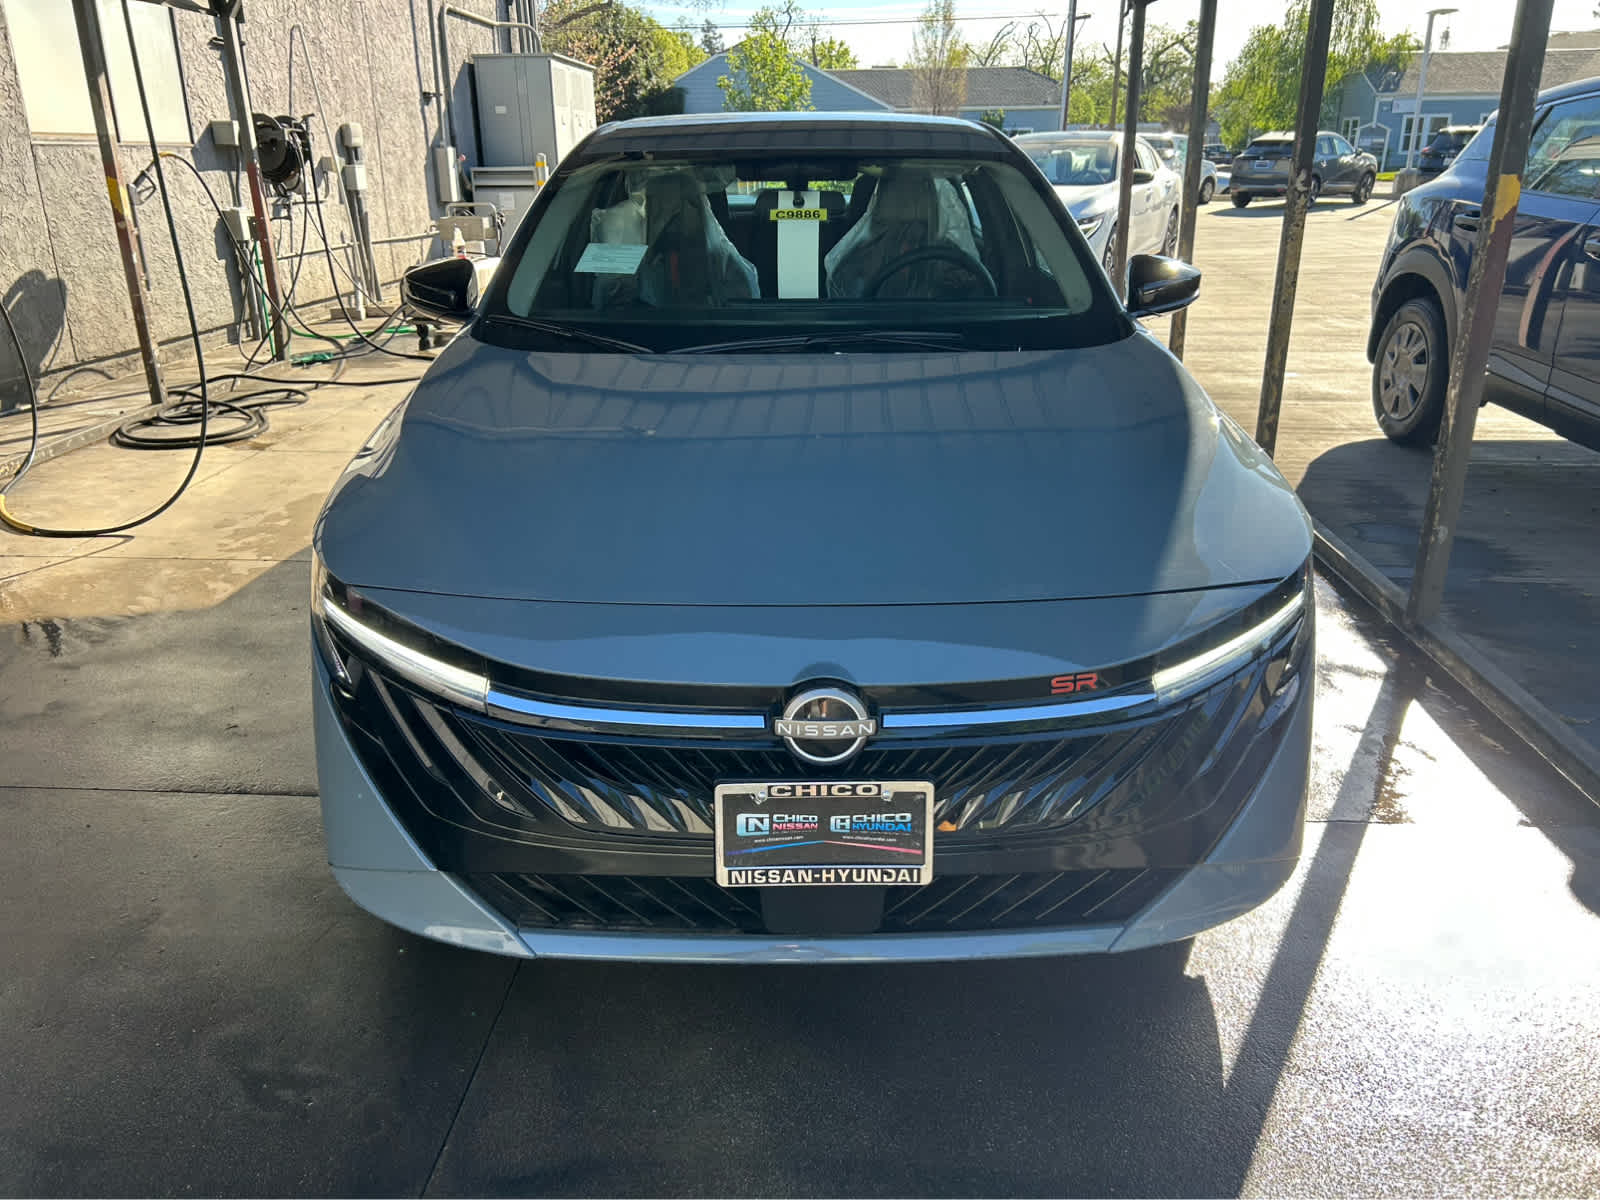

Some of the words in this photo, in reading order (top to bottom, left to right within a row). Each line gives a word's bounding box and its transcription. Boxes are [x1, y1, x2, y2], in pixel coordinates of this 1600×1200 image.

[775, 210, 821, 219] C9886
[1051, 672, 1097, 695] SR
[777, 722, 873, 737] NISSAN
[770, 784, 879, 797] CHICO
[772, 814, 818, 823] CHICO
[852, 813, 912, 823] CHICO
[772, 822, 818, 831] NISSAN
[852, 822, 912, 832] HYUNDAI
[731, 868, 918, 884] NISSAN-HYUNDAI
